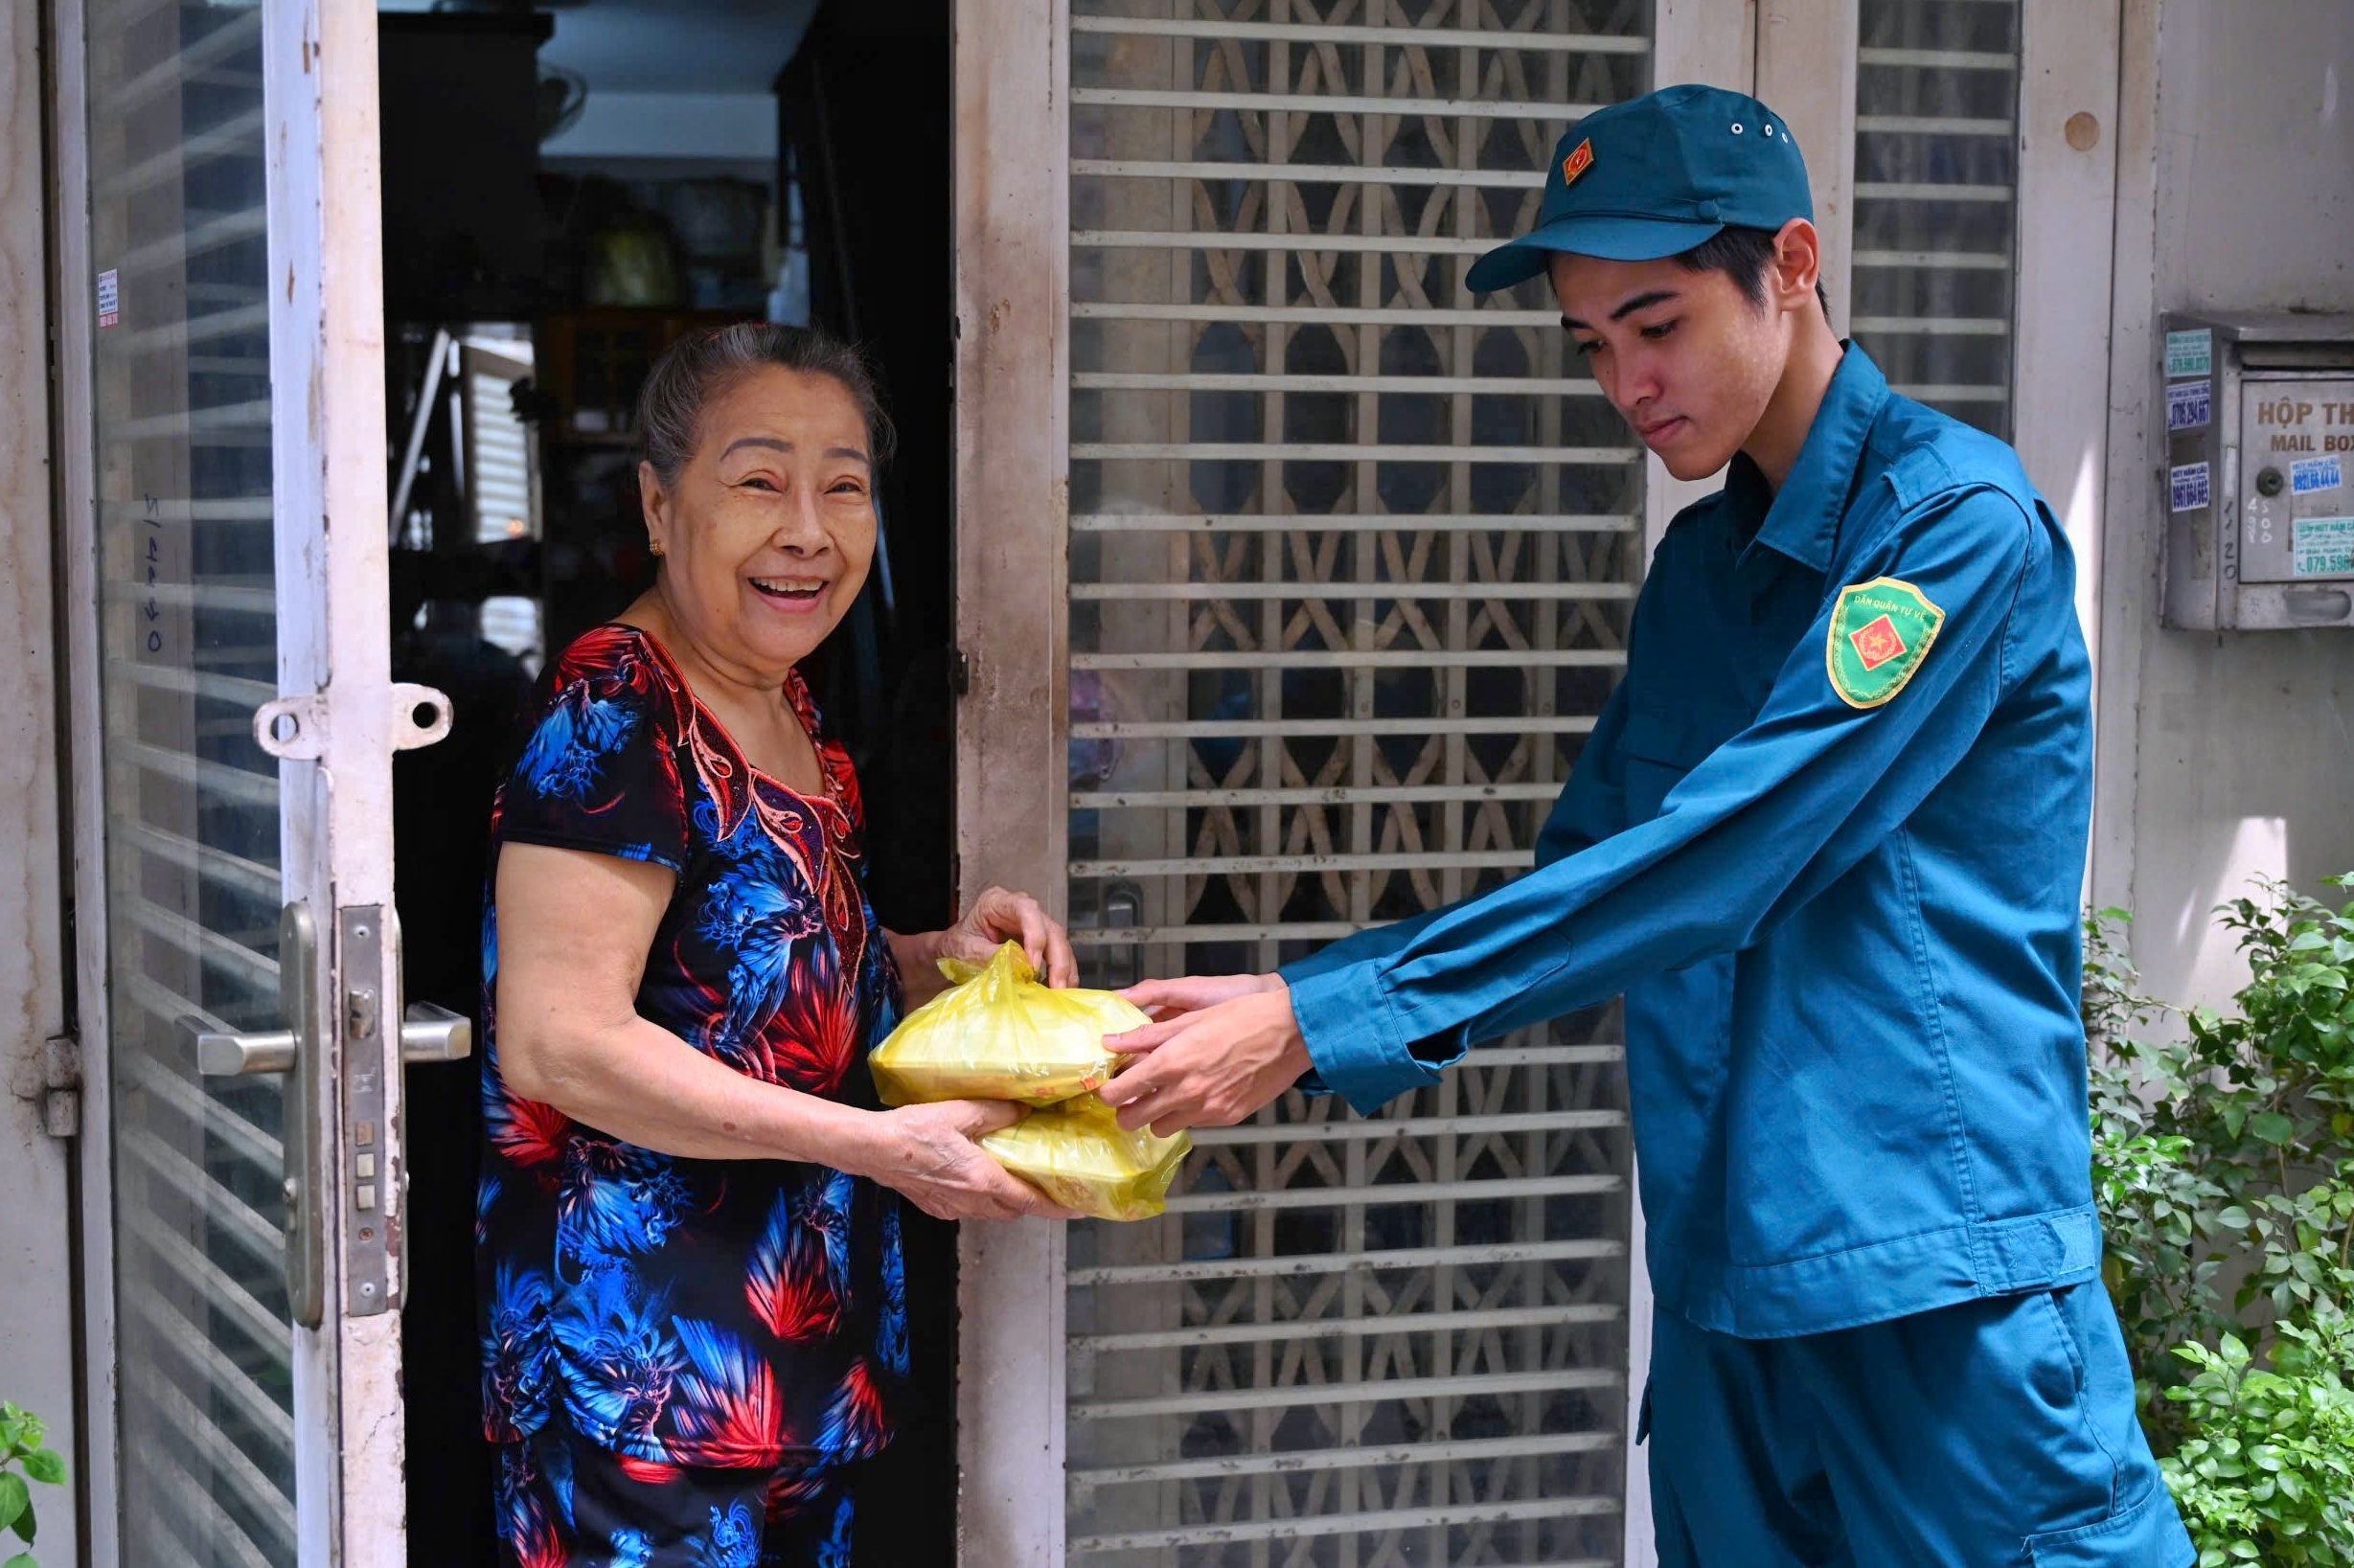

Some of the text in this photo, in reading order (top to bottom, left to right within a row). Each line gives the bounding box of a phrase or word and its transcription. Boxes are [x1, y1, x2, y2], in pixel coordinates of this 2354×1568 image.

[2257, 396, 2313, 429] HỘP
[2271, 434, 2316, 451] MAIL
[1854, 594, 1873, 606] DÂN
[1873, 600, 1899, 612] QUÂN
